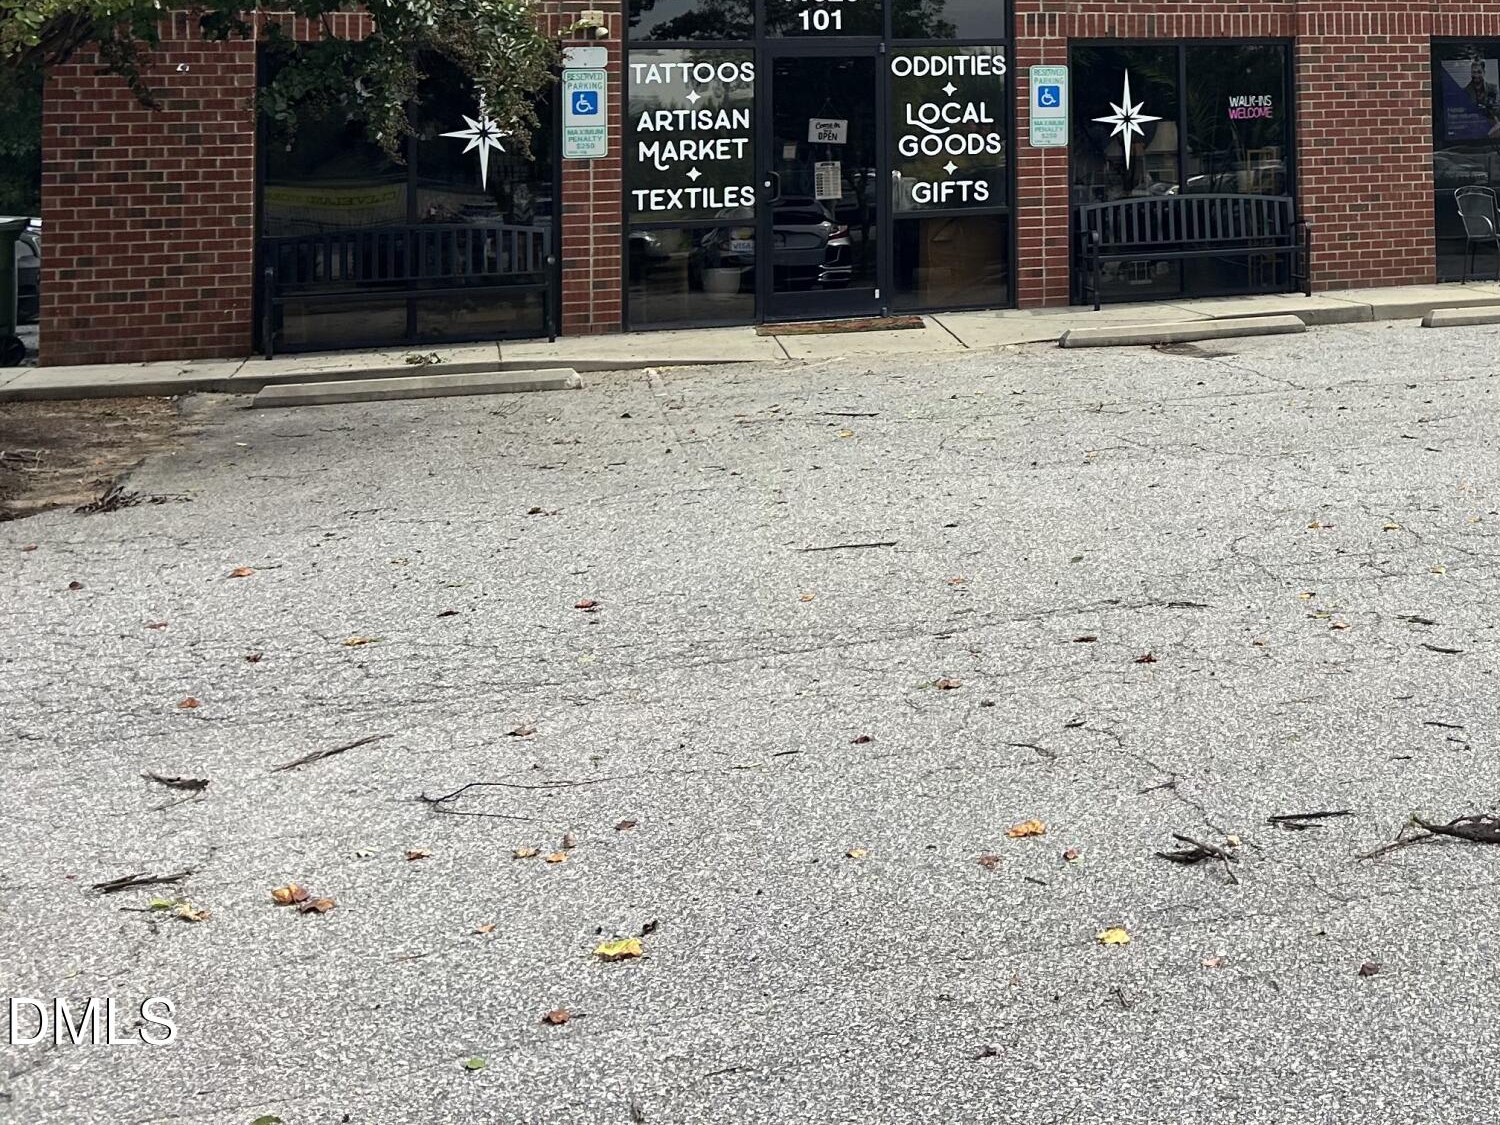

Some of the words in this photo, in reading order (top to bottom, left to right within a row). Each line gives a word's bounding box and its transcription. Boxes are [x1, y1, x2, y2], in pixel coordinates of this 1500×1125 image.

[798, 9, 843, 31] 101
[567, 73, 603, 81] RESERVED
[630, 61, 755, 84] TATTOOS
[891, 54, 1007, 78] ODDITIES
[567, 82, 603, 90] PARKING
[1228, 107, 1273, 119] WELCOME
[1229, 95, 1272, 107] WALK-INS
[636, 108, 750, 132] ARTISAN
[906, 101, 994, 134] LOCAL
[638, 138, 748, 171] MARKET
[898, 133, 1002, 157] GOODS
[632, 185, 755, 211] TEXTILES
[911, 180, 990, 204] GIFTS
